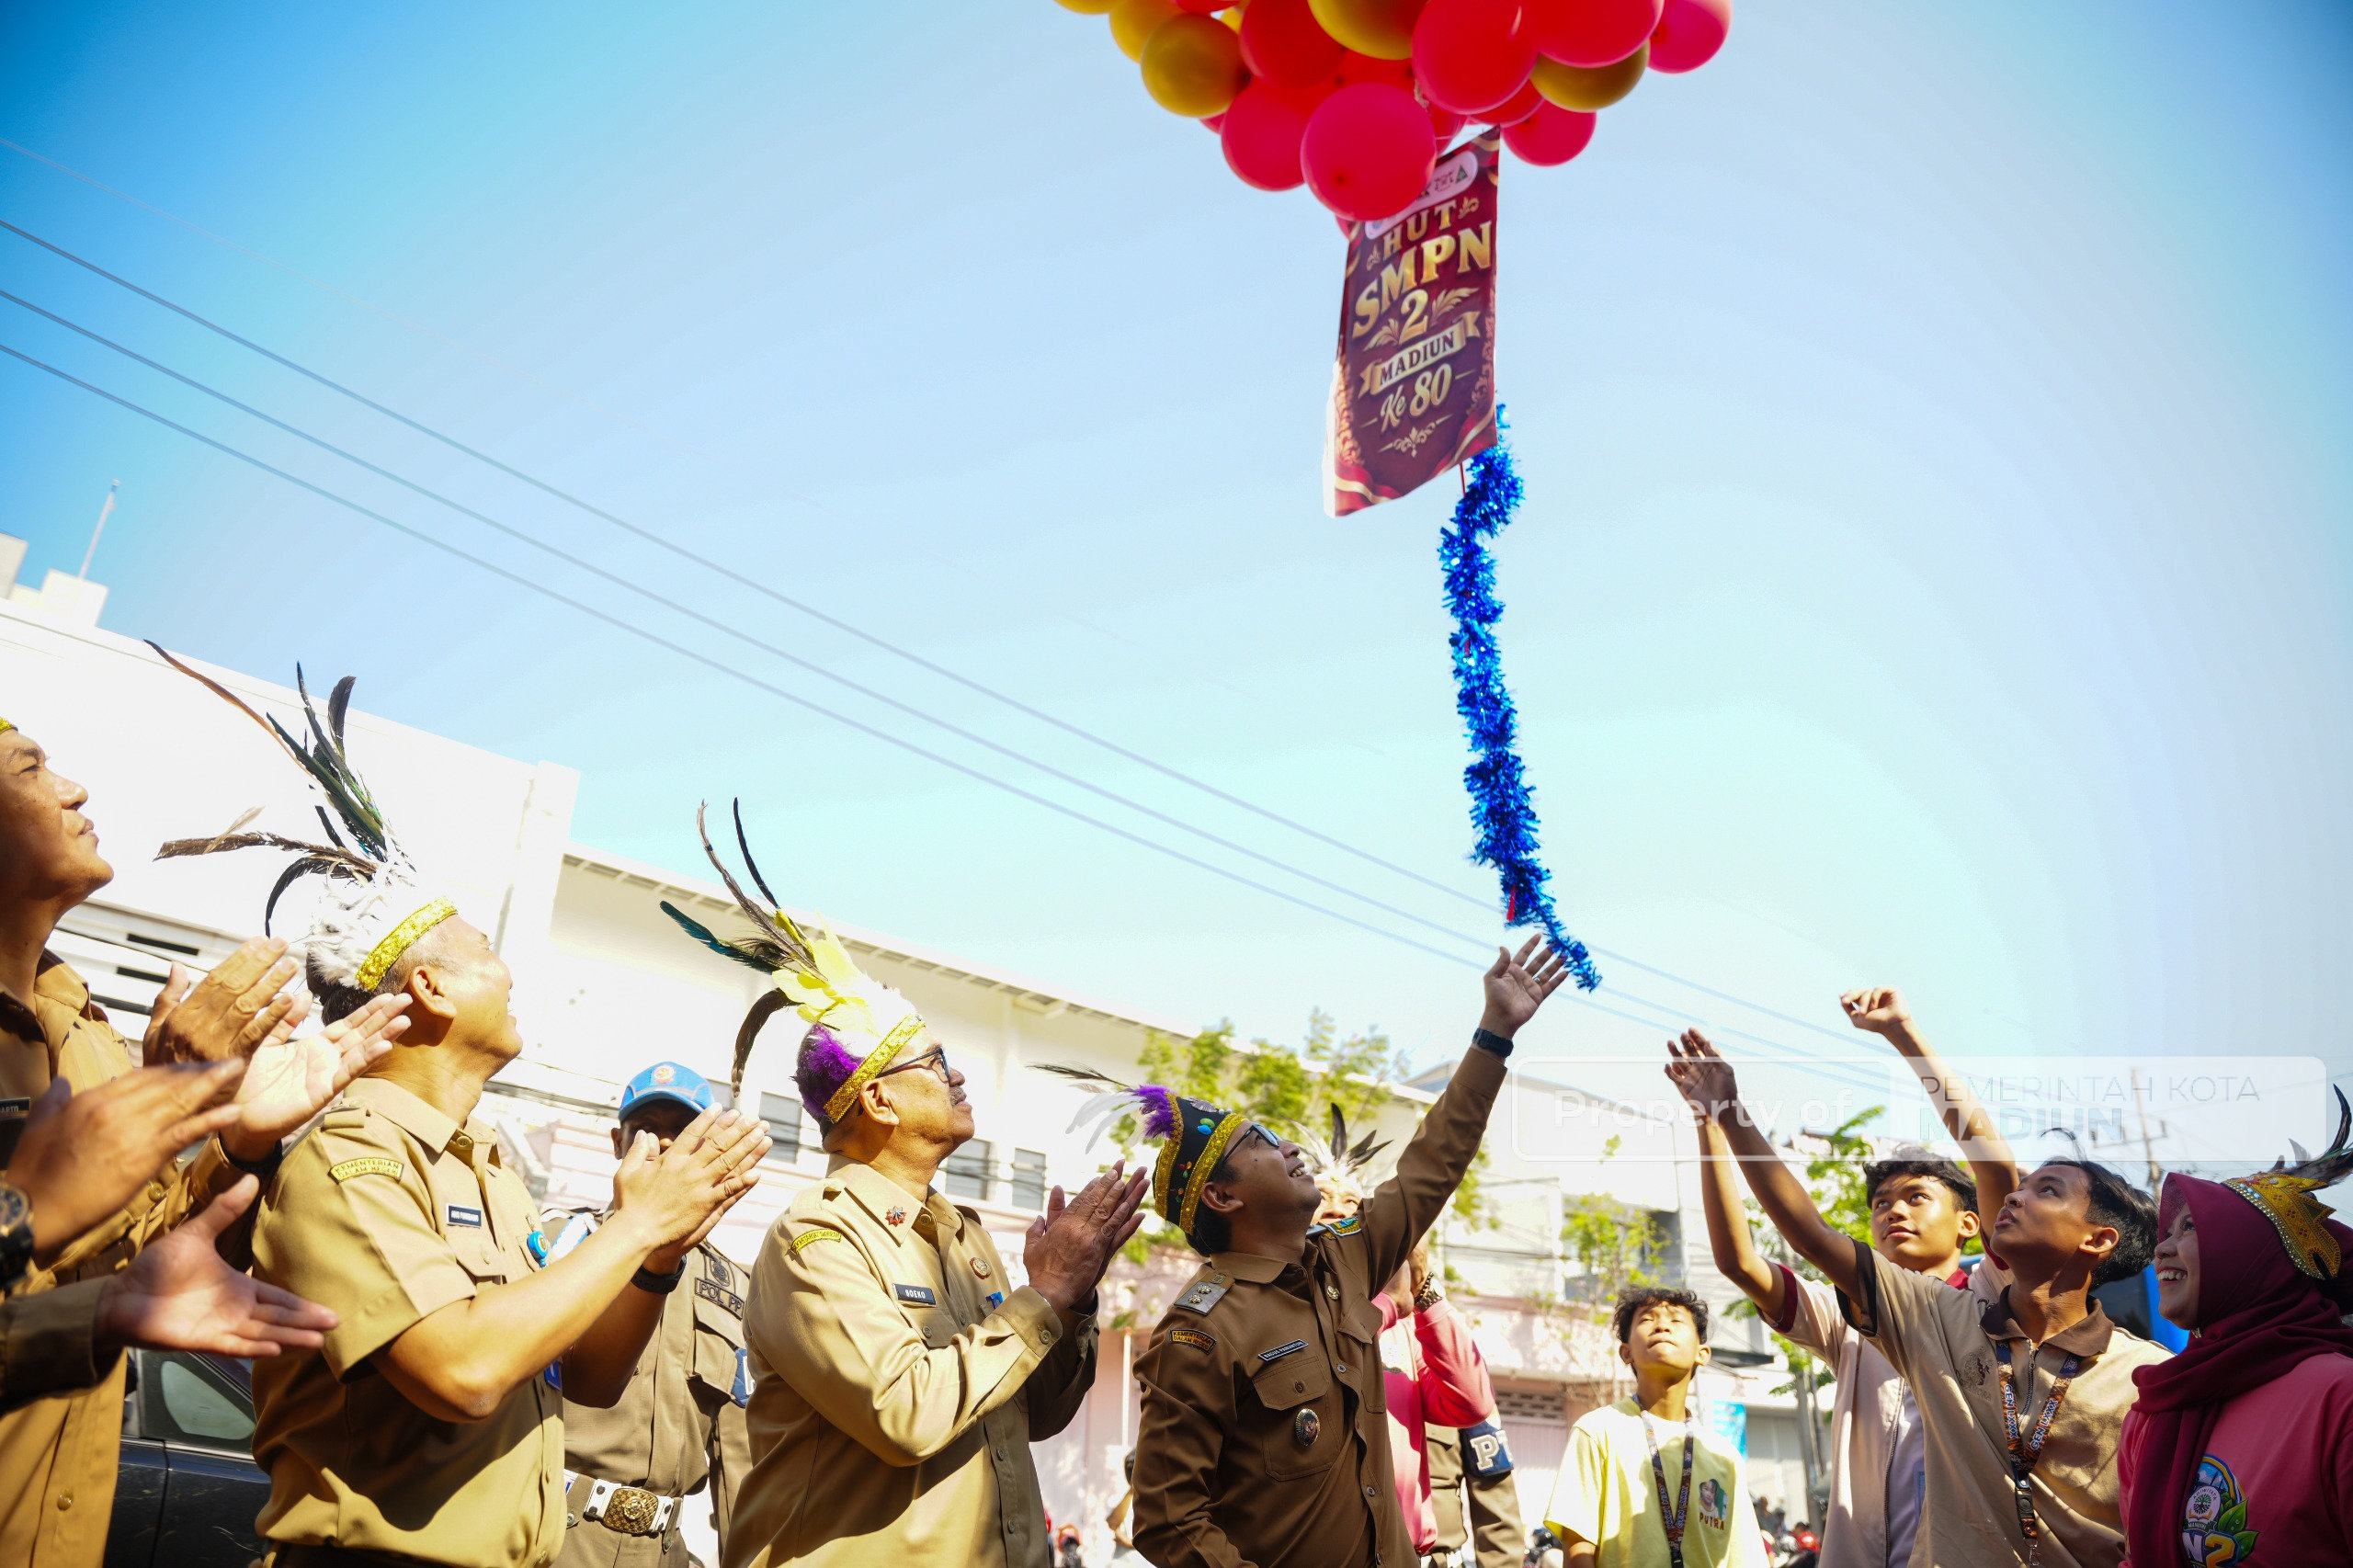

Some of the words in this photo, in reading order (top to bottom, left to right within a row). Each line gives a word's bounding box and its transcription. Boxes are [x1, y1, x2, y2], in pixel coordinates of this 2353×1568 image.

[1382, 199, 1457, 261] HUT
[1352, 221, 1492, 339] SMPN
[1398, 289, 1429, 346] 2
[1380, 331, 1455, 386] MADIUN
[1380, 384, 1407, 433] Ke
[1409, 363, 1452, 416] 80
[699, 1281, 724, 1304] POL
[729, 1294, 742, 1312] PP
[1173, 1331, 1213, 1346] KEMENTERIAN
[2003, 1383, 2015, 1407] GEN
[2006, 1409, 2018, 1439] LXXX
[2029, 1427, 2046, 1450] GEN
[2039, 1398, 2059, 1427] LXXX
[1699, 1511, 1725, 1531] PUTRA
